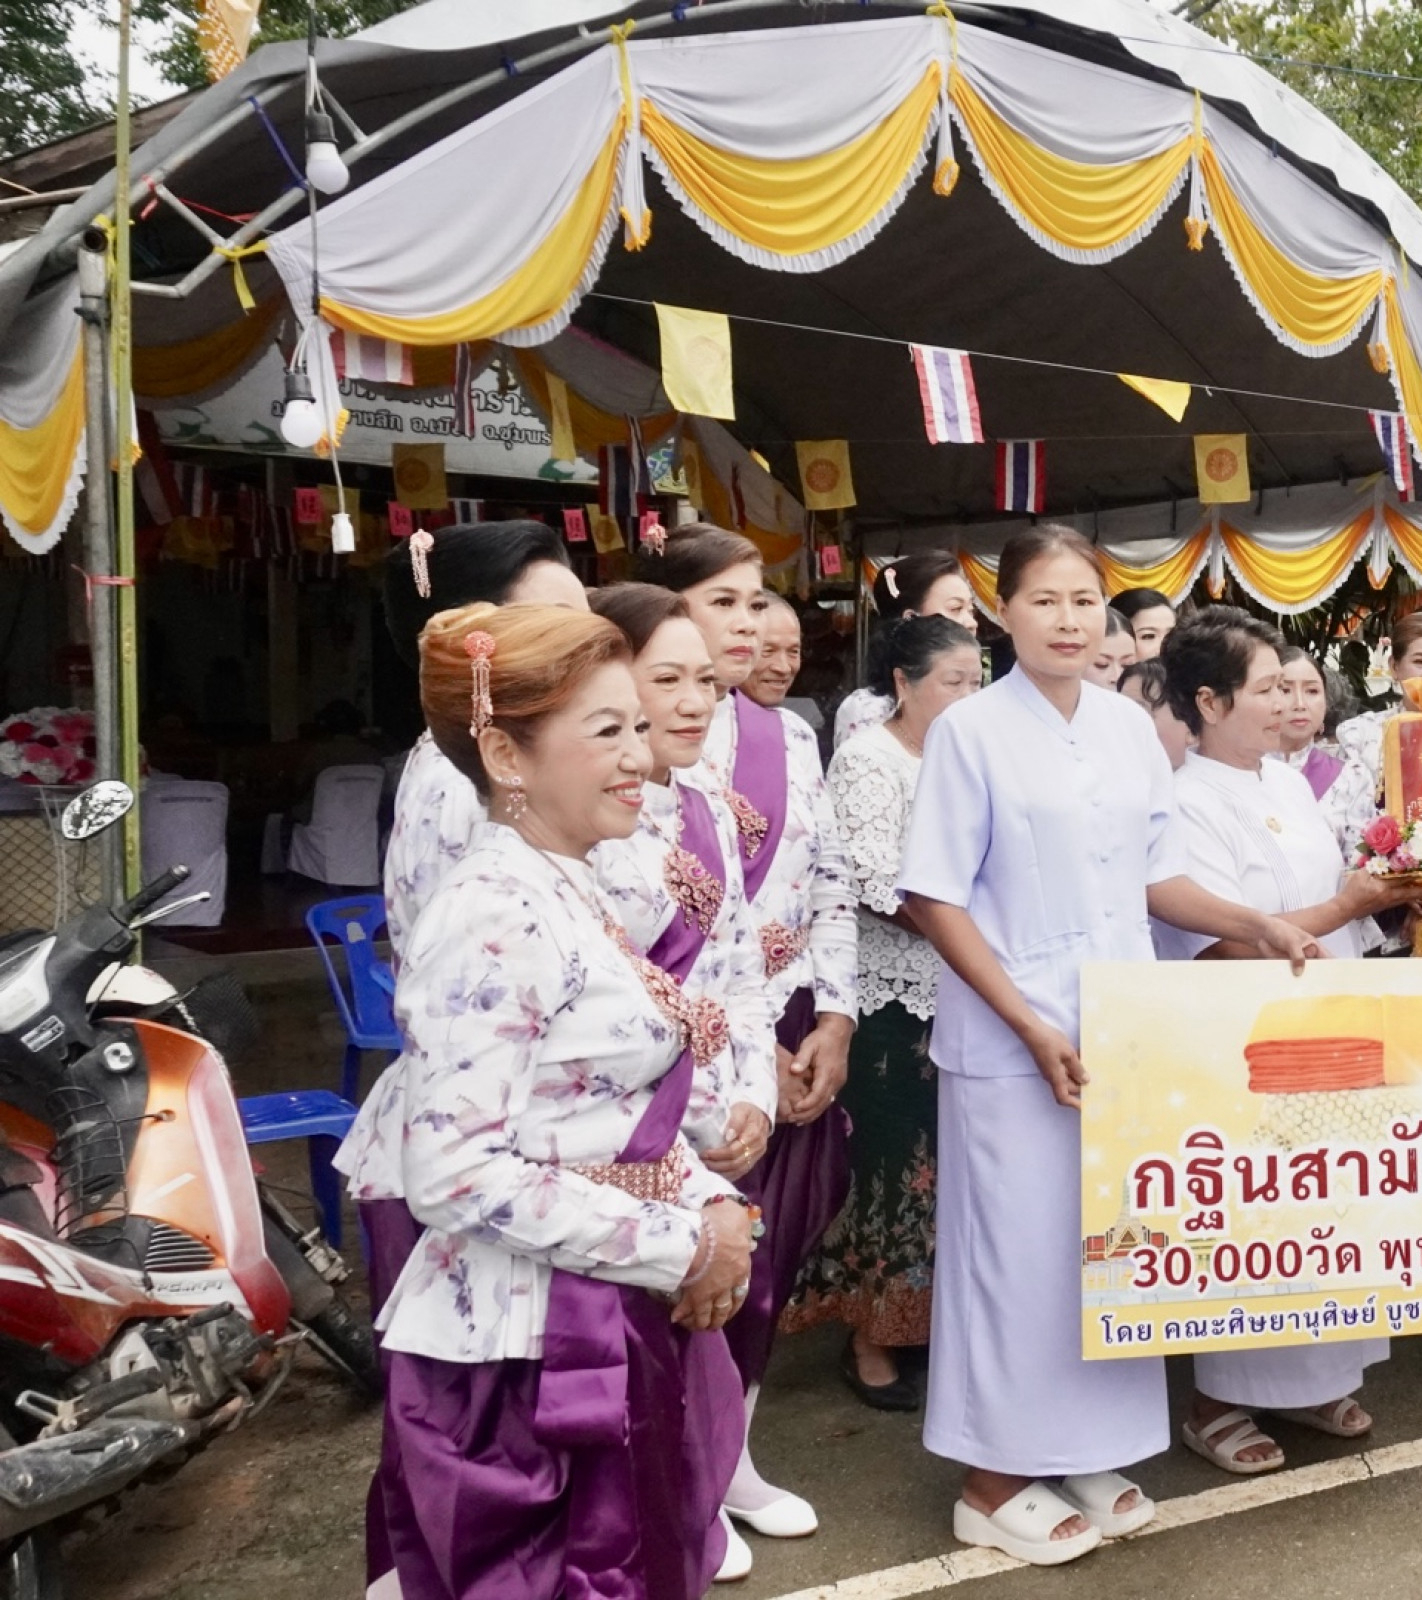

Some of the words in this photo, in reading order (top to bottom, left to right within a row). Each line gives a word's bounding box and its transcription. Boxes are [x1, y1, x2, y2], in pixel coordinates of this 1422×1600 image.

[1133, 1226, 1363, 1294] 30,000วัด
[1102, 1315, 1152, 1347] โดย
[1165, 1296, 1376, 1345] คณะศิษยานุศิษย์
